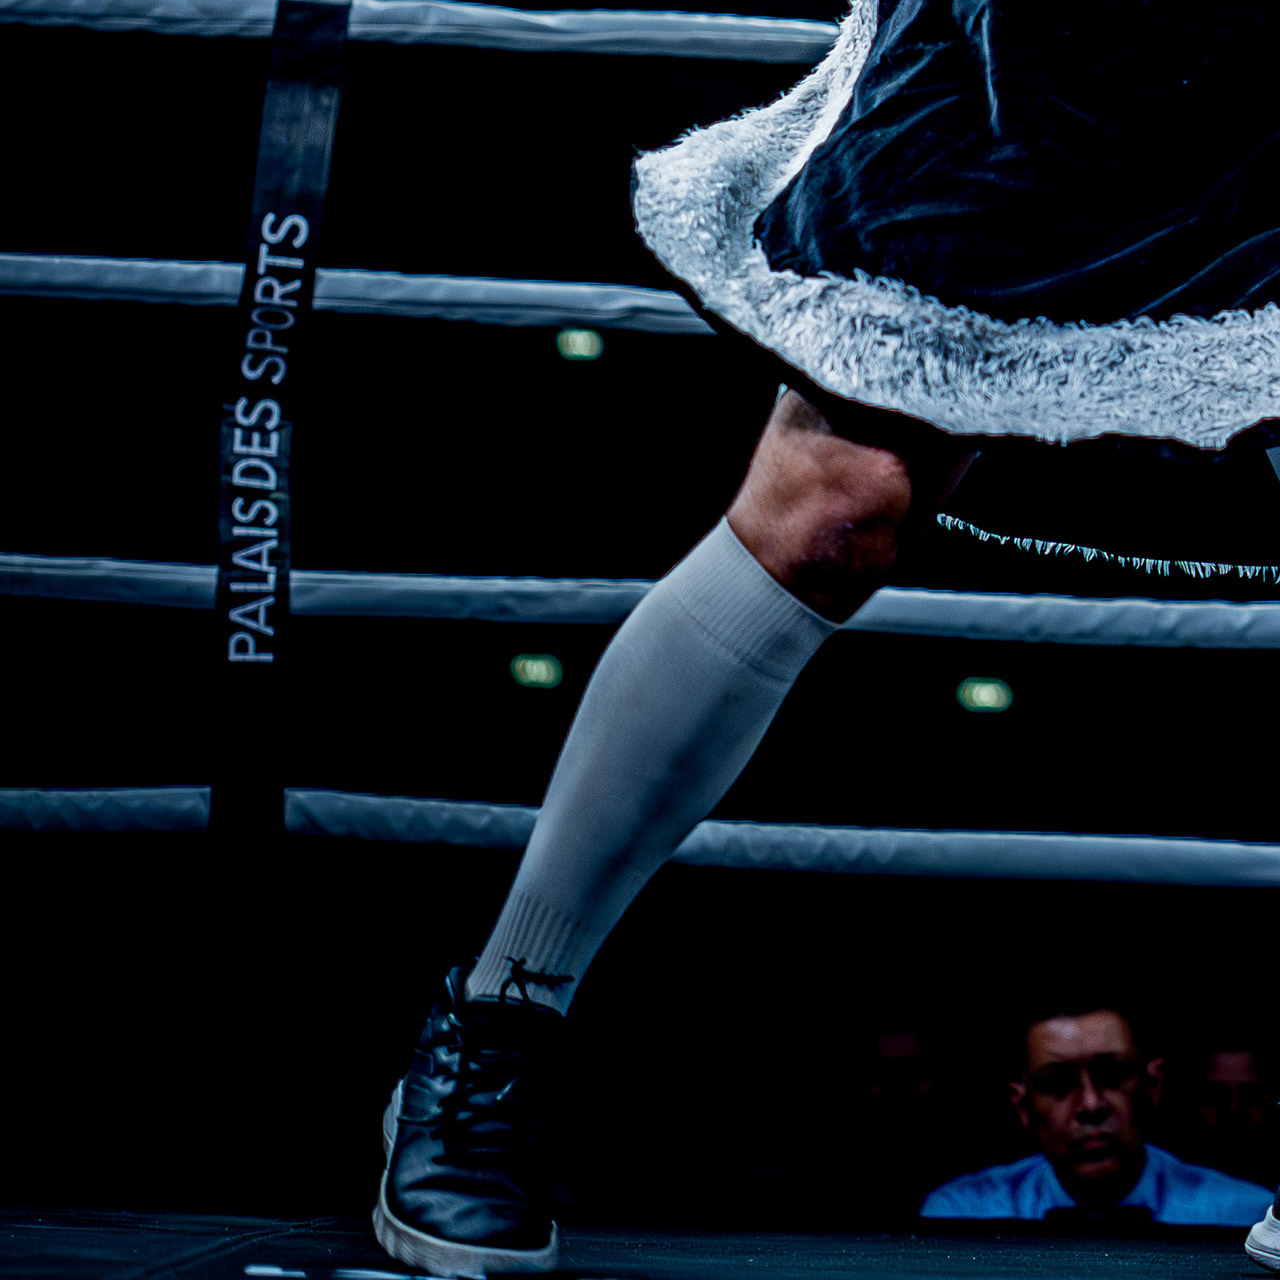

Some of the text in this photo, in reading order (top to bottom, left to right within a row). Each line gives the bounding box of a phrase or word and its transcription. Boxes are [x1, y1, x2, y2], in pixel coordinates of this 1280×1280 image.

[227, 211, 310, 663] PALAIS DES SPORTS
